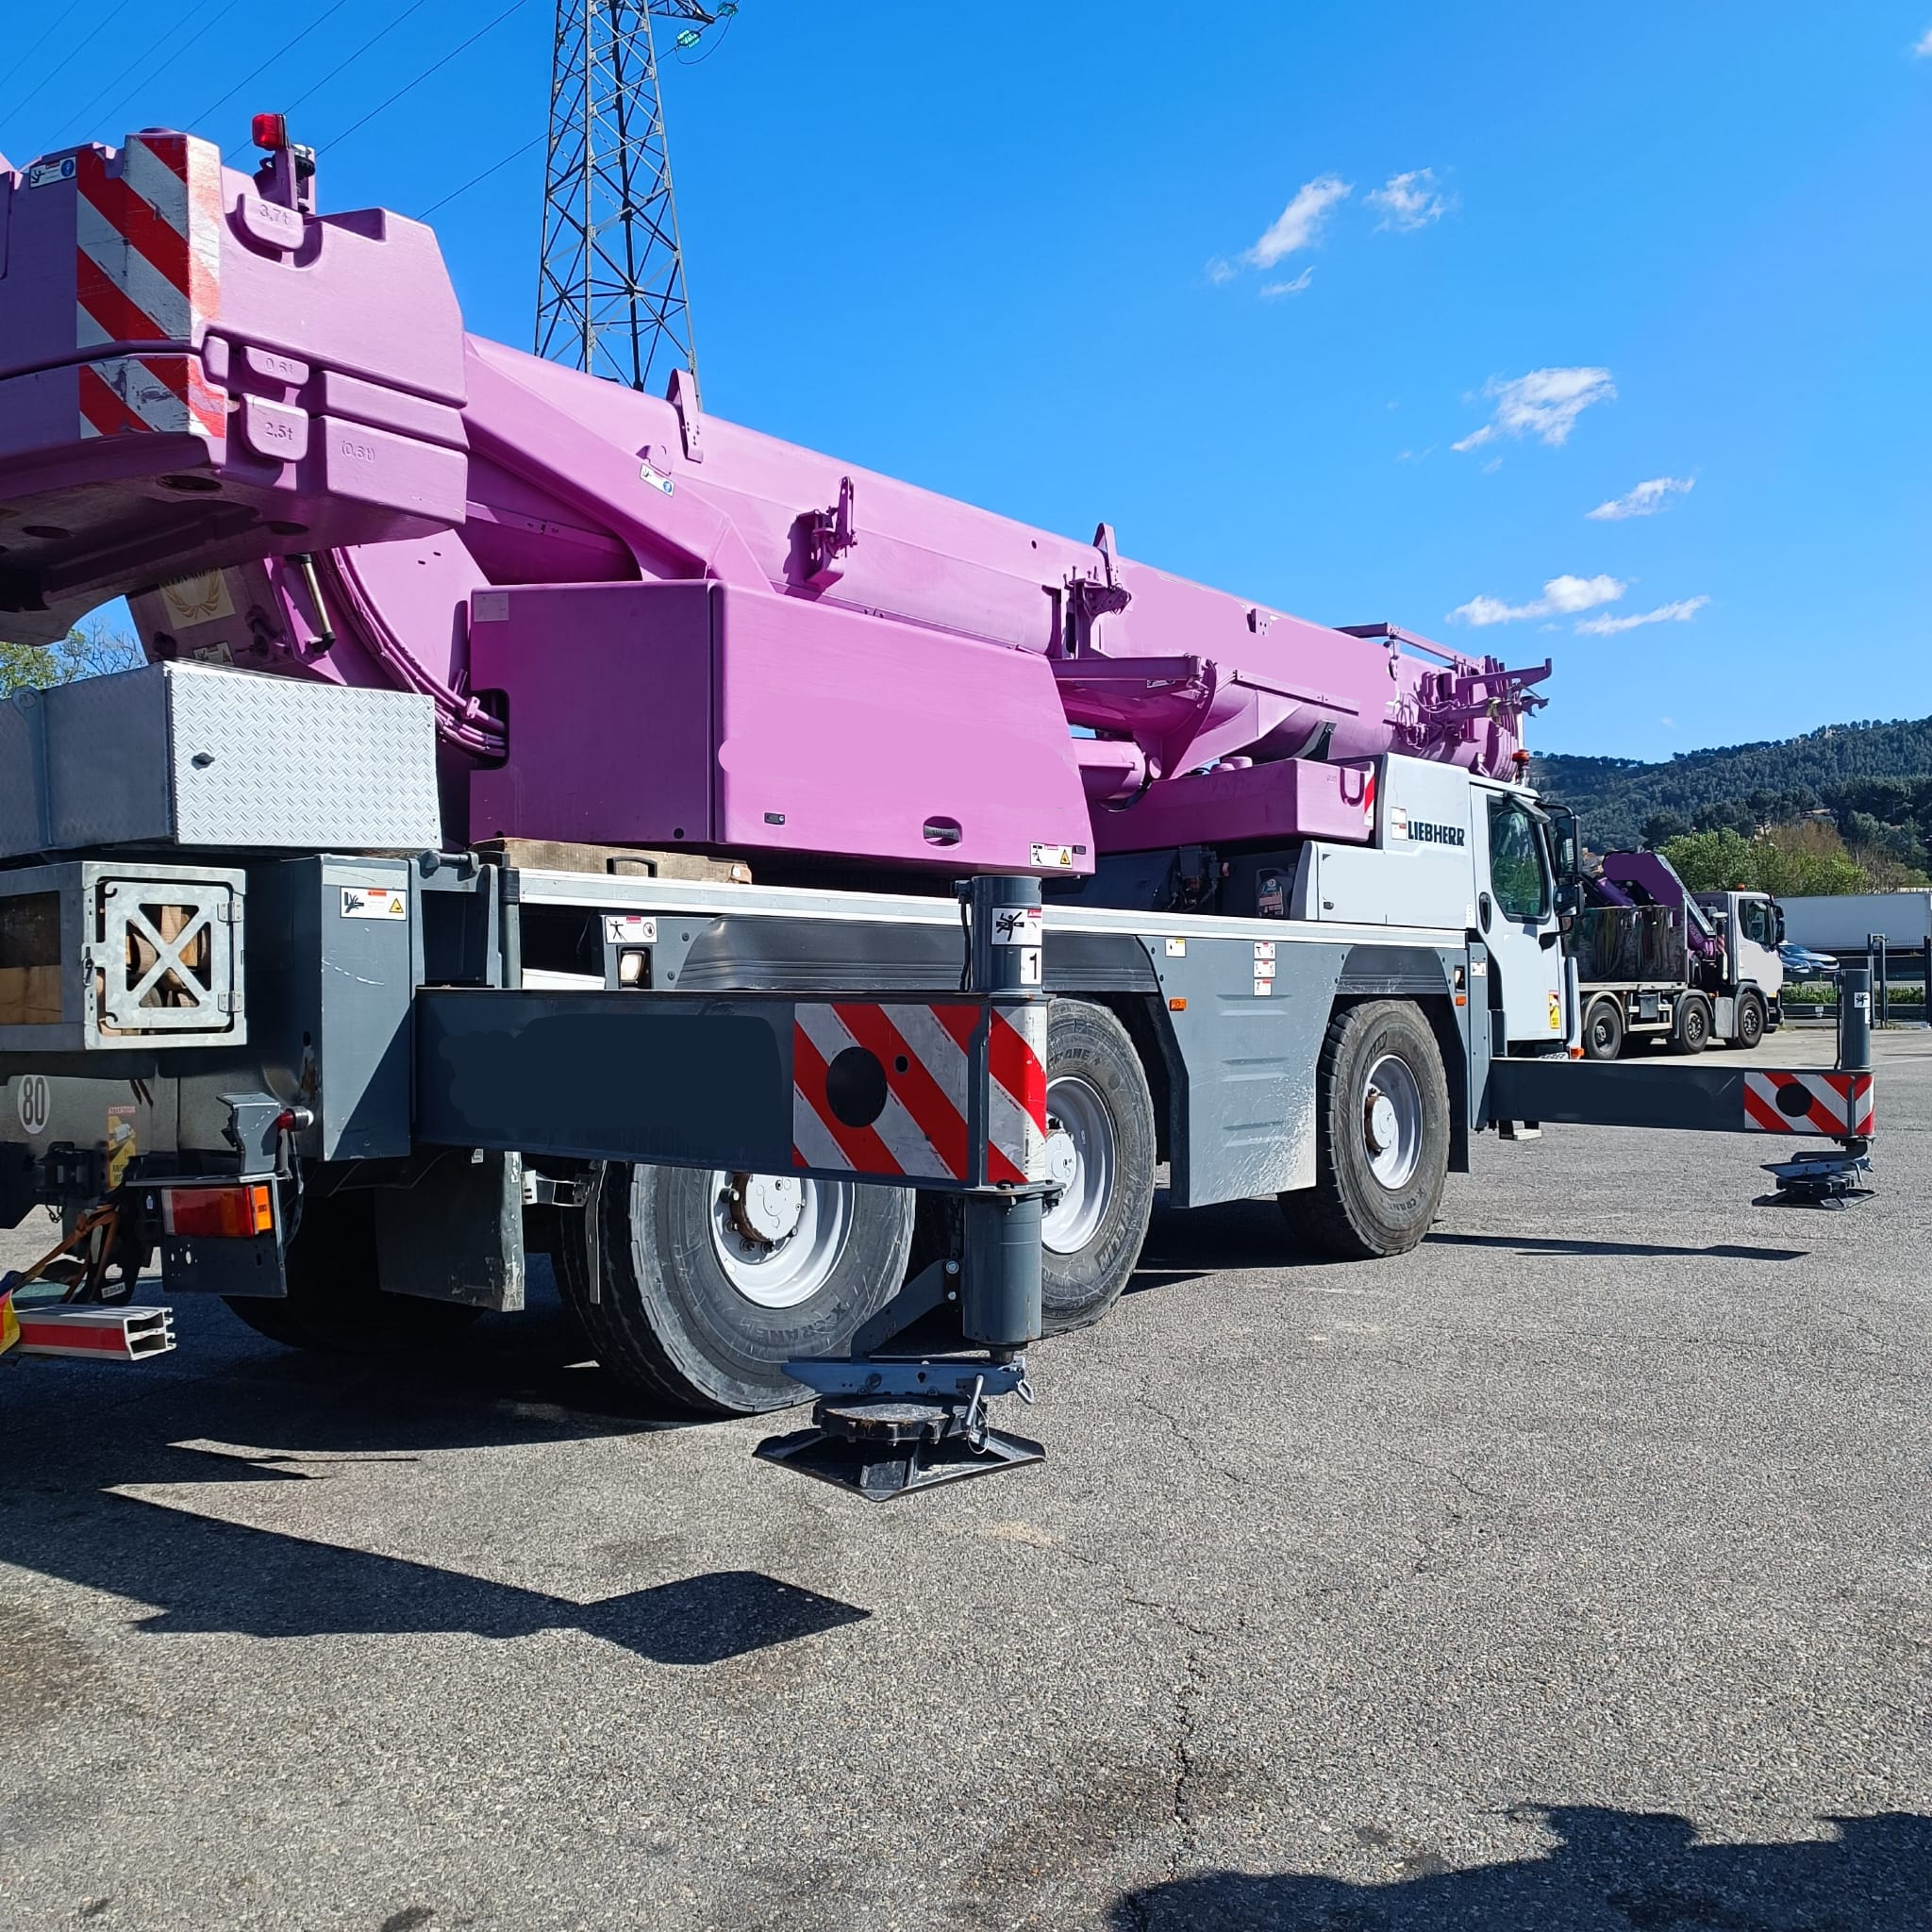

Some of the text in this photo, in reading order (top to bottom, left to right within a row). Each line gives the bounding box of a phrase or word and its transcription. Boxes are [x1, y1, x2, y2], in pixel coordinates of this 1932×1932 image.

[264, 422, 293, 441] 2.5t
[1407, 820, 1465, 847] LIEBHERR
[1029, 952, 1038, 980] 1
[22, 1075, 46, 1127] 80
